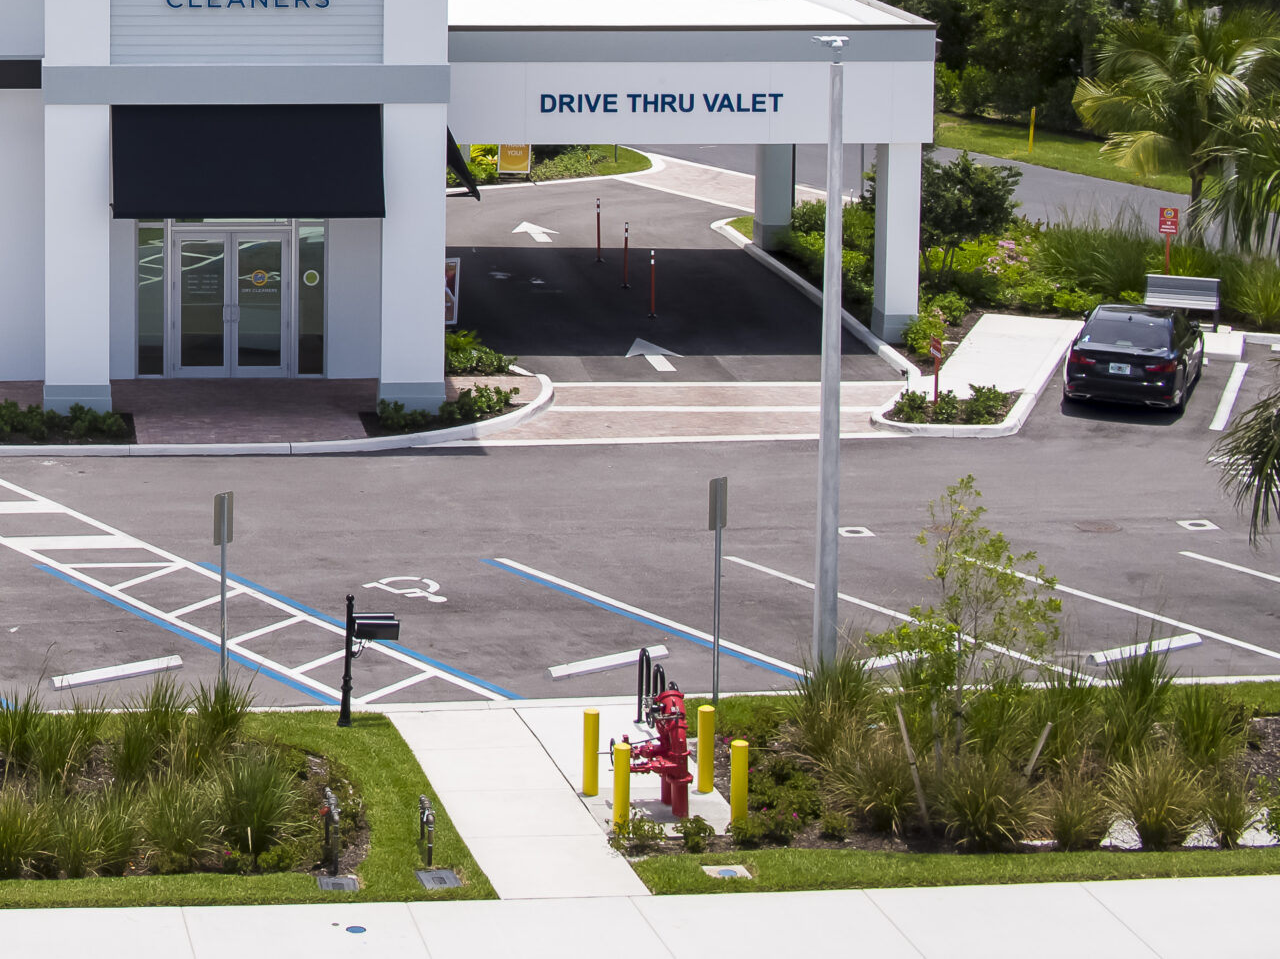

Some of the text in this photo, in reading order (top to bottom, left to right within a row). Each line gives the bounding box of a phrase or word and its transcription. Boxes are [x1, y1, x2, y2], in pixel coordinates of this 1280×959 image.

[540, 93, 784, 114] DRIVE THRU VALET
